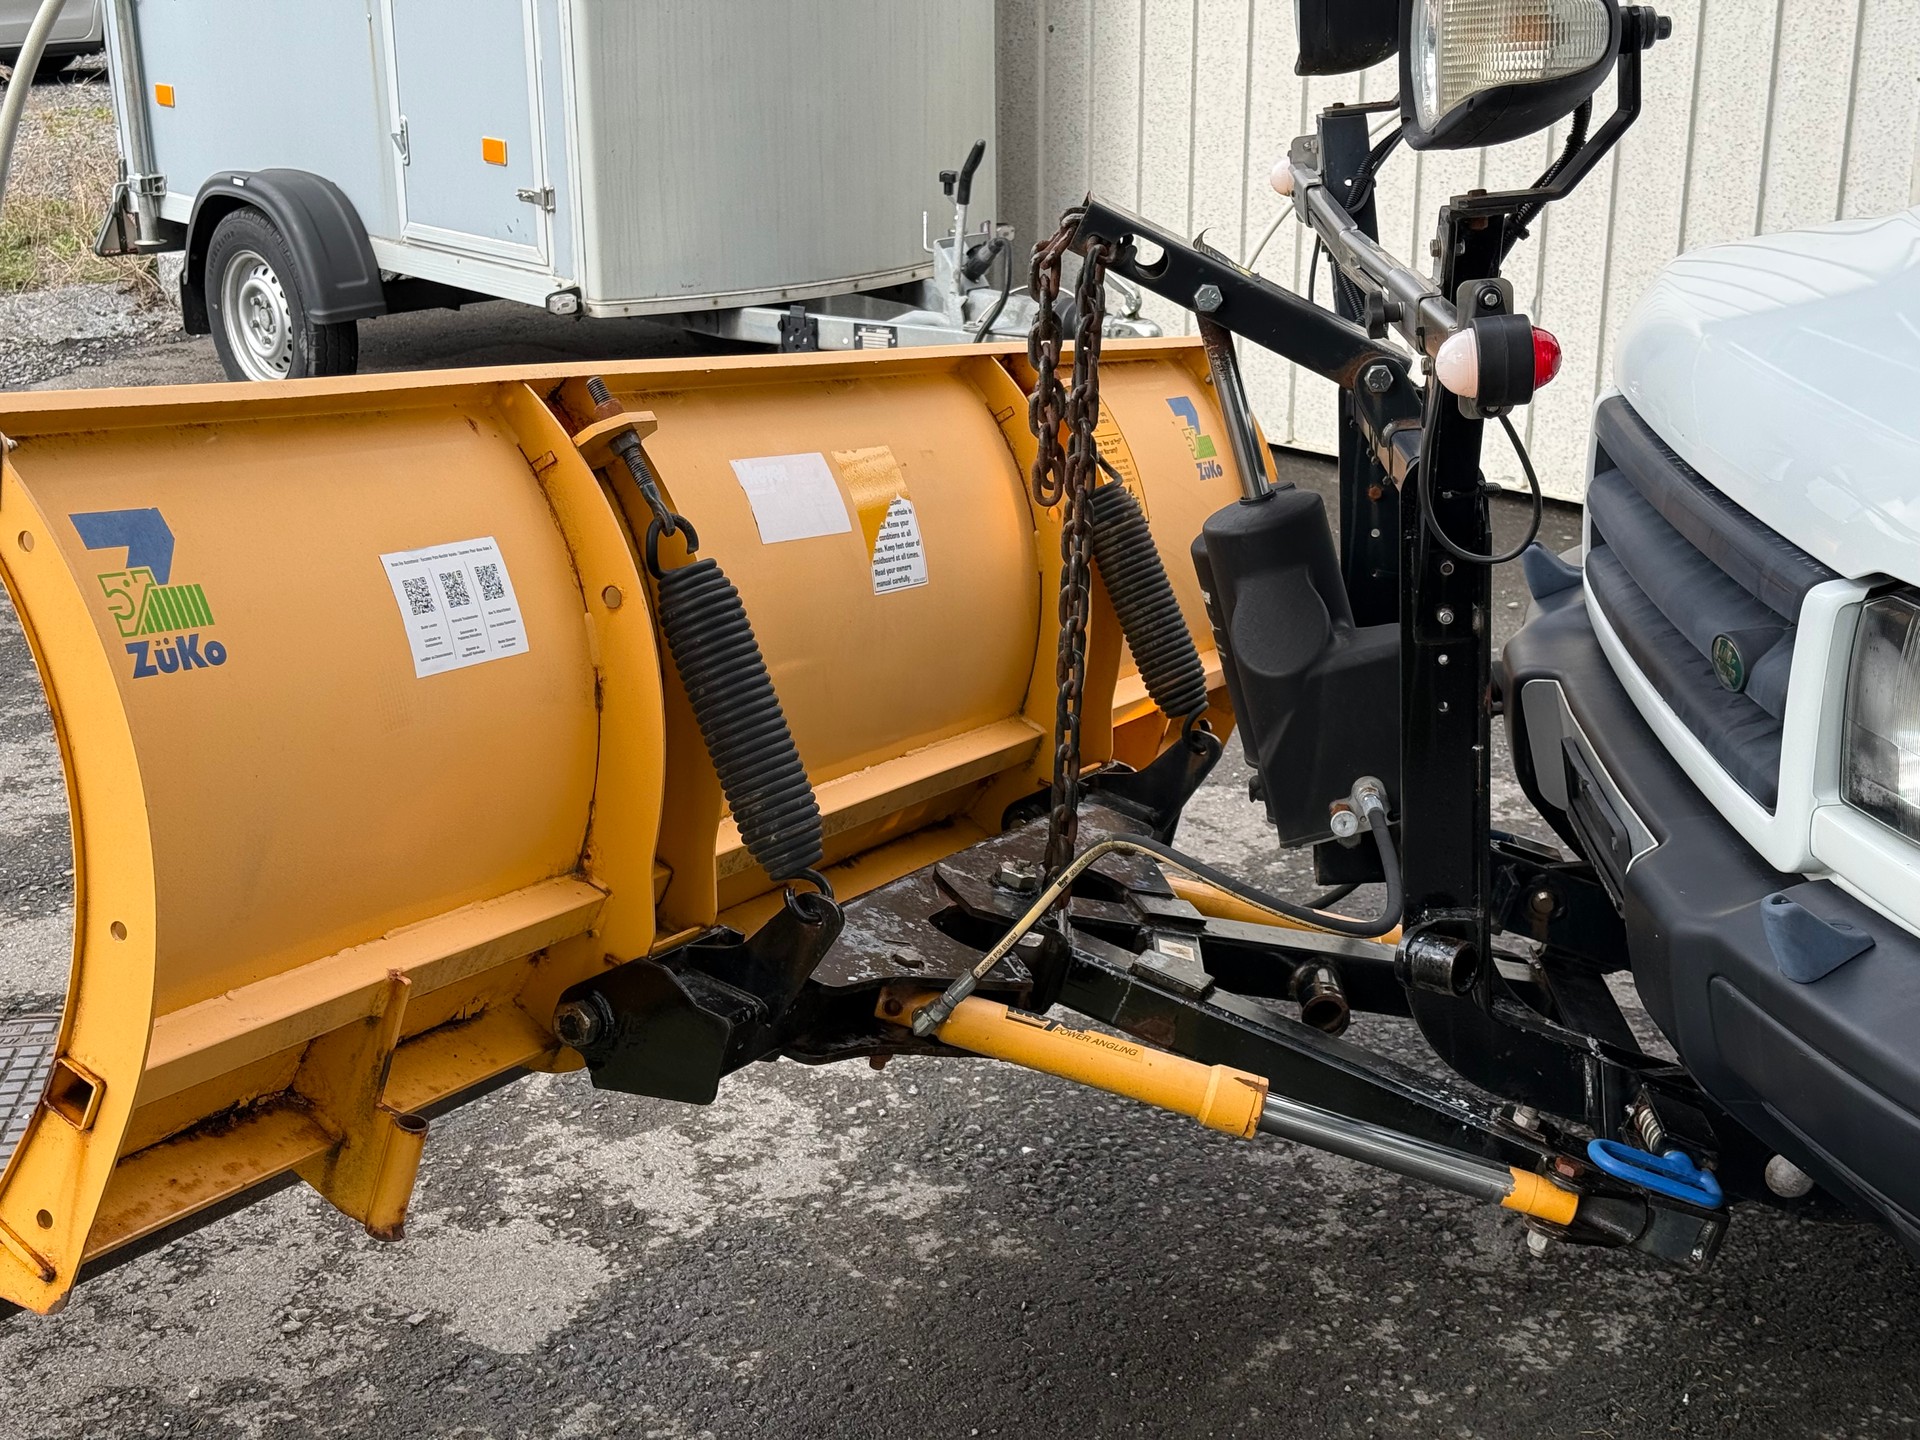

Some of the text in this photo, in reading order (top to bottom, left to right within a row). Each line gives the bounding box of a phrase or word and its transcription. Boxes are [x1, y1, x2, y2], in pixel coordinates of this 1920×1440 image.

[1196, 460, 1223, 480] ZüKo
[894, 508, 908, 516] vehicle
[900, 520, 909, 528] your
[879, 532, 900, 541] conditions
[884, 544, 895, 552] Keep
[873, 556, 895, 565] moldboard
[875, 568, 886, 577] Read
[886, 567, 895, 575] your
[876, 579, 892, 588] manual
[892, 575, 911, 585] carefully.
[125, 633, 227, 679] ZüKo
[993, 949, 1003, 959] PSI
[1002, 932, 1018, 950] BURST
[1053, 1026, 1138, 1056] POWER ANGLING
